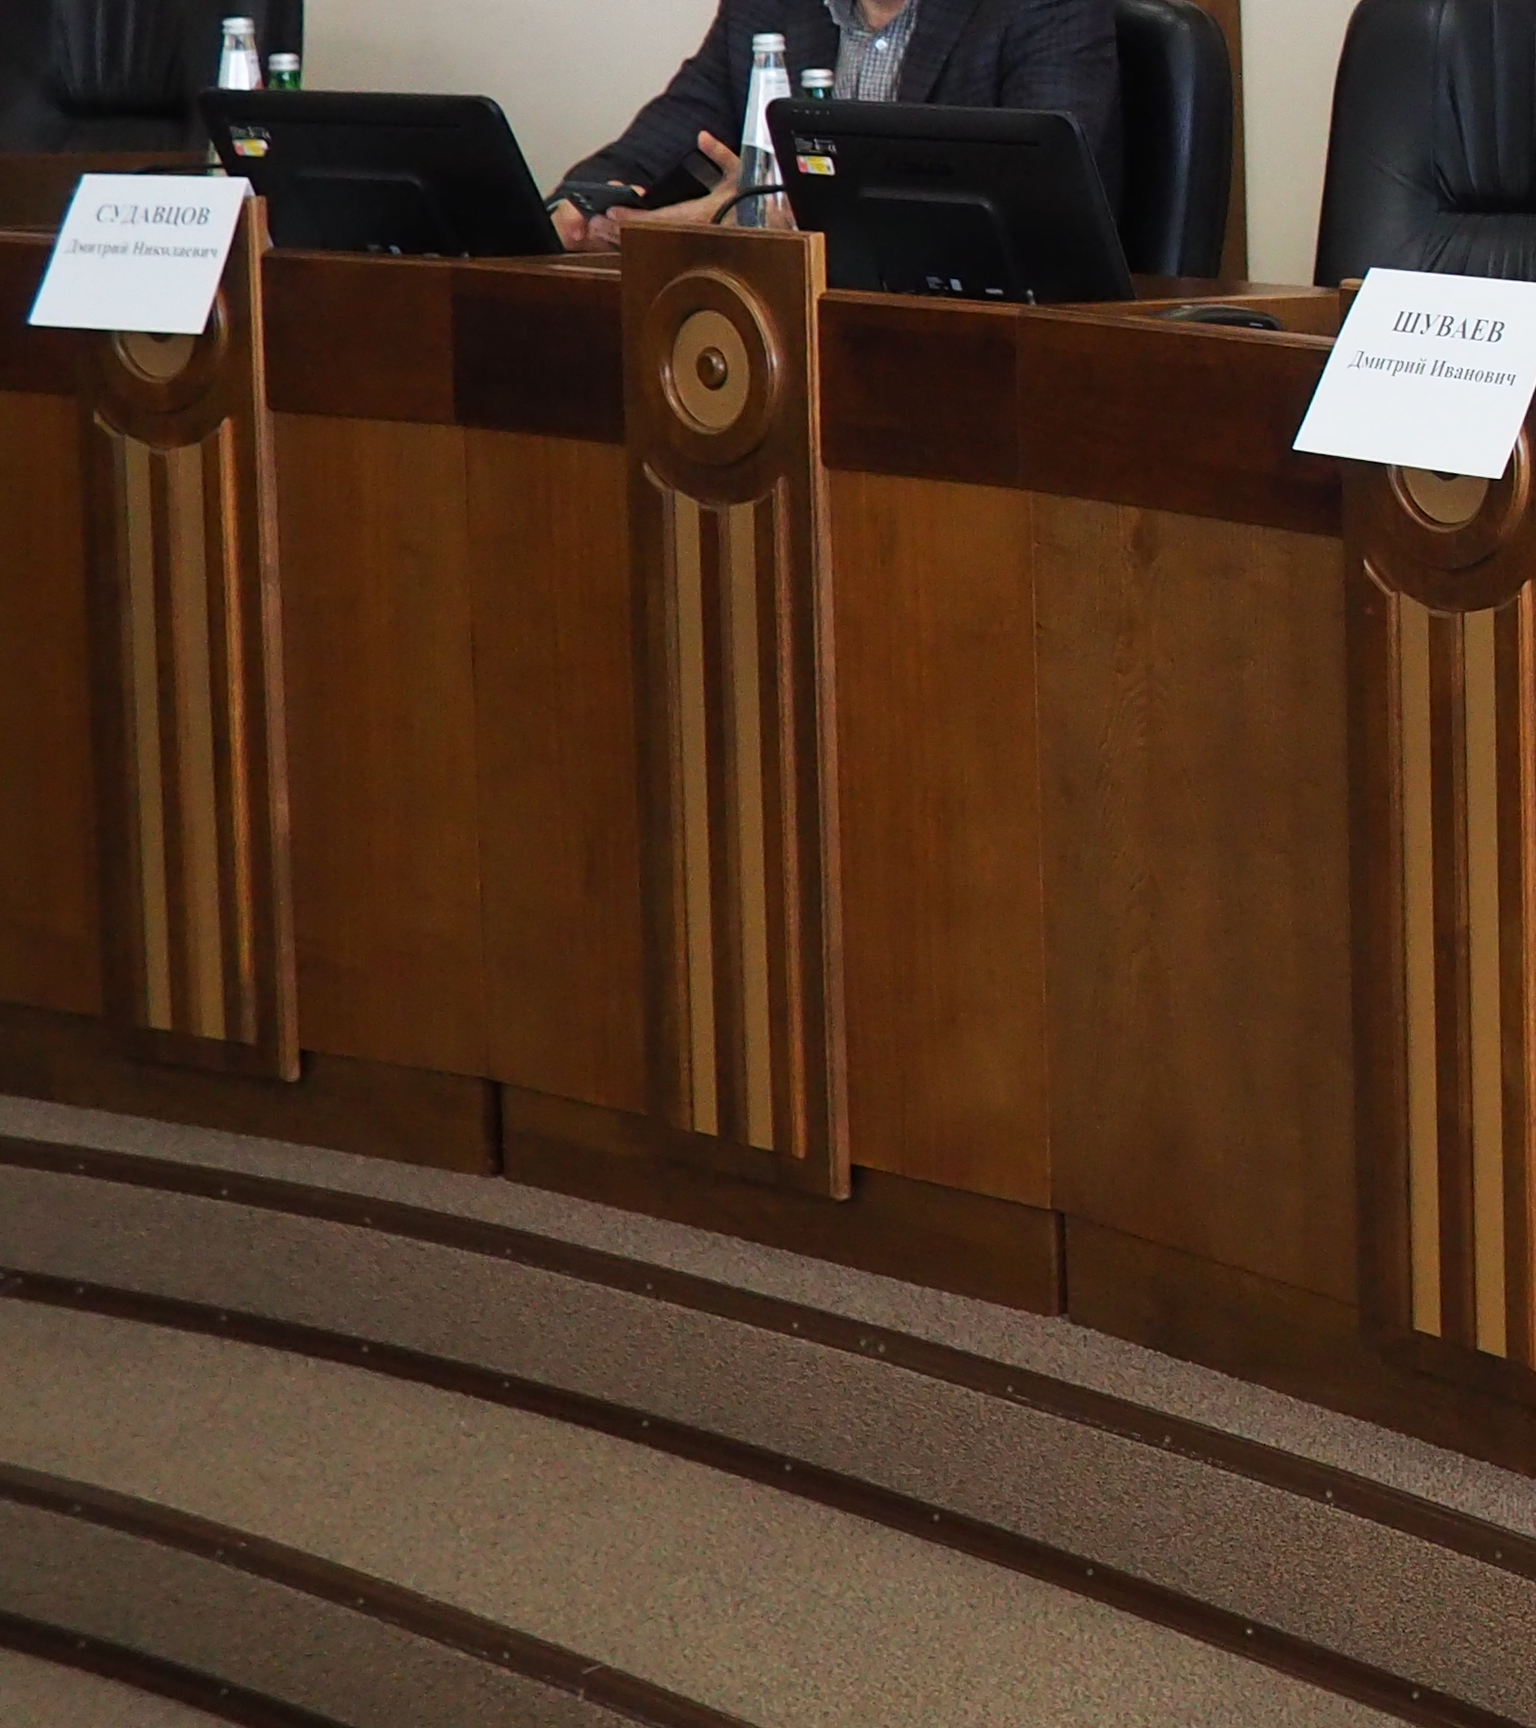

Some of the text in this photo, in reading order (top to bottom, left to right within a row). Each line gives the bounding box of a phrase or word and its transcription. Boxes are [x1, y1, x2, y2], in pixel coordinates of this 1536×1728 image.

[96, 204, 211, 227] СУДАВЦОВ
[65, 239, 219, 259] Дмитрий Николаевич
[1391, 309, 1506, 344] ШУВАЕВ
[1347, 350, 1518, 387] Дмитрий Иванович
